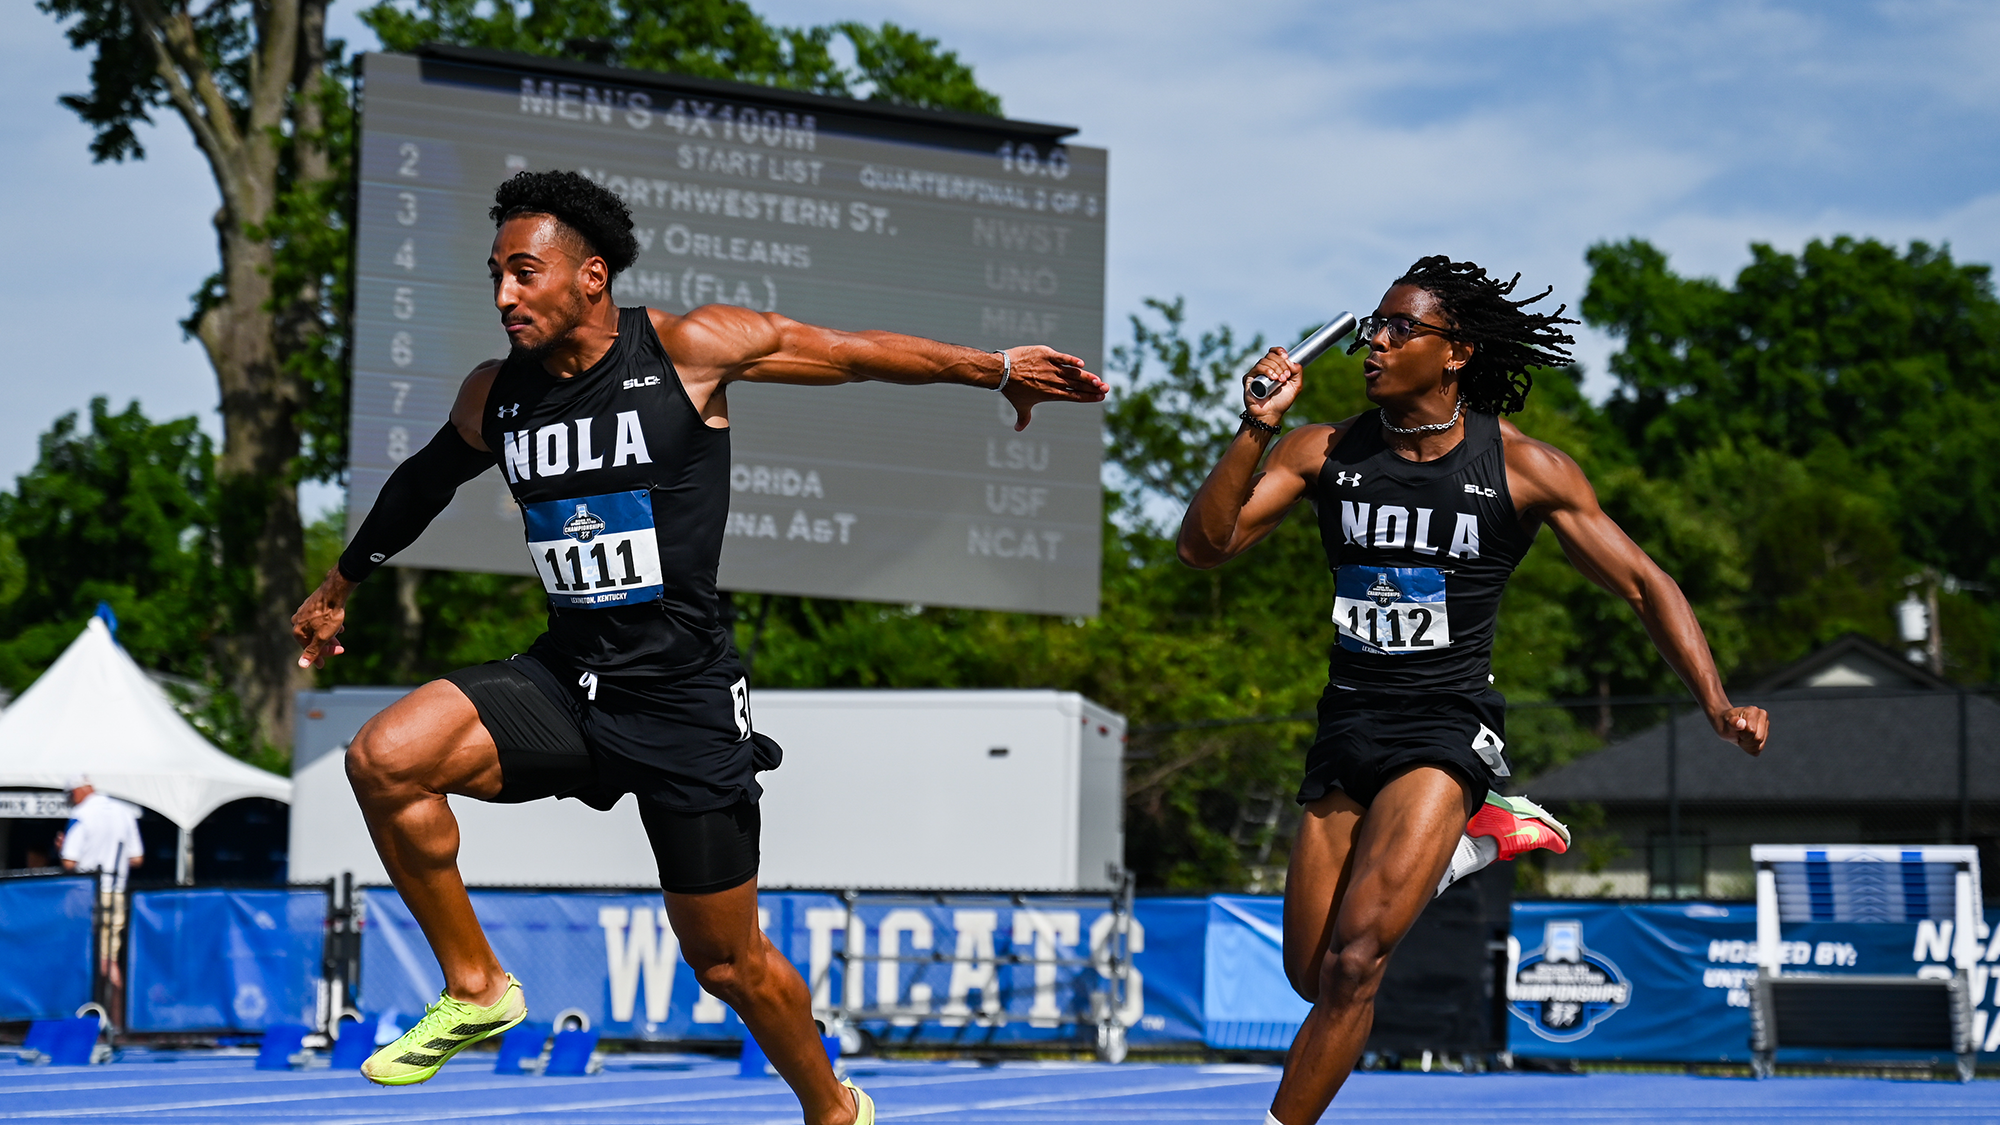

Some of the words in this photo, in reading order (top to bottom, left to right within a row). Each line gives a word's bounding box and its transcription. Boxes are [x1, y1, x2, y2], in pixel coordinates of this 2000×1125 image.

[520, 77, 654, 130] MEN'S
[663, 99, 817, 150] 4X100M
[397, 142, 420, 178] 2
[676, 144, 762, 179] START
[768, 157, 824, 186] LIST
[859, 165, 1029, 210] QUARTERFINAL
[395, 191, 417, 227] 3
[849, 202, 898, 236] ST.
[664, 223, 812, 269] ORLEANS
[973, 216, 1070, 253] NWST
[393, 237, 417, 273] 4
[612, 269, 673, 301] AMI
[985, 263, 1058, 296] UNO
[392, 287, 416, 321] 5
[390, 331, 414, 368] 6
[390, 381, 411, 415] 7
[387, 426, 410, 464] 8
[503, 410, 653, 484] NOLA
[985, 438, 1049, 471] LSU
[731, 463, 824, 499] ORIDA
[985, 484, 1049, 518] USF
[564, 522, 604, 533] CHAMPIONSHIPS
[786, 510, 858, 545] A&T
[967, 524, 1063, 560] NCAT
[1341, 500, 1480, 559] NOLA
[545, 539, 642, 592] 1111
[597, 592, 628, 603] KENTUCKY
[1367, 590, 1400, 598] CHAMPIONSHIPS
[1348, 605, 1434, 648] 1112
[599, 906, 1146, 1027] WDCATS
[1814, 941, 1858, 967] BY:
